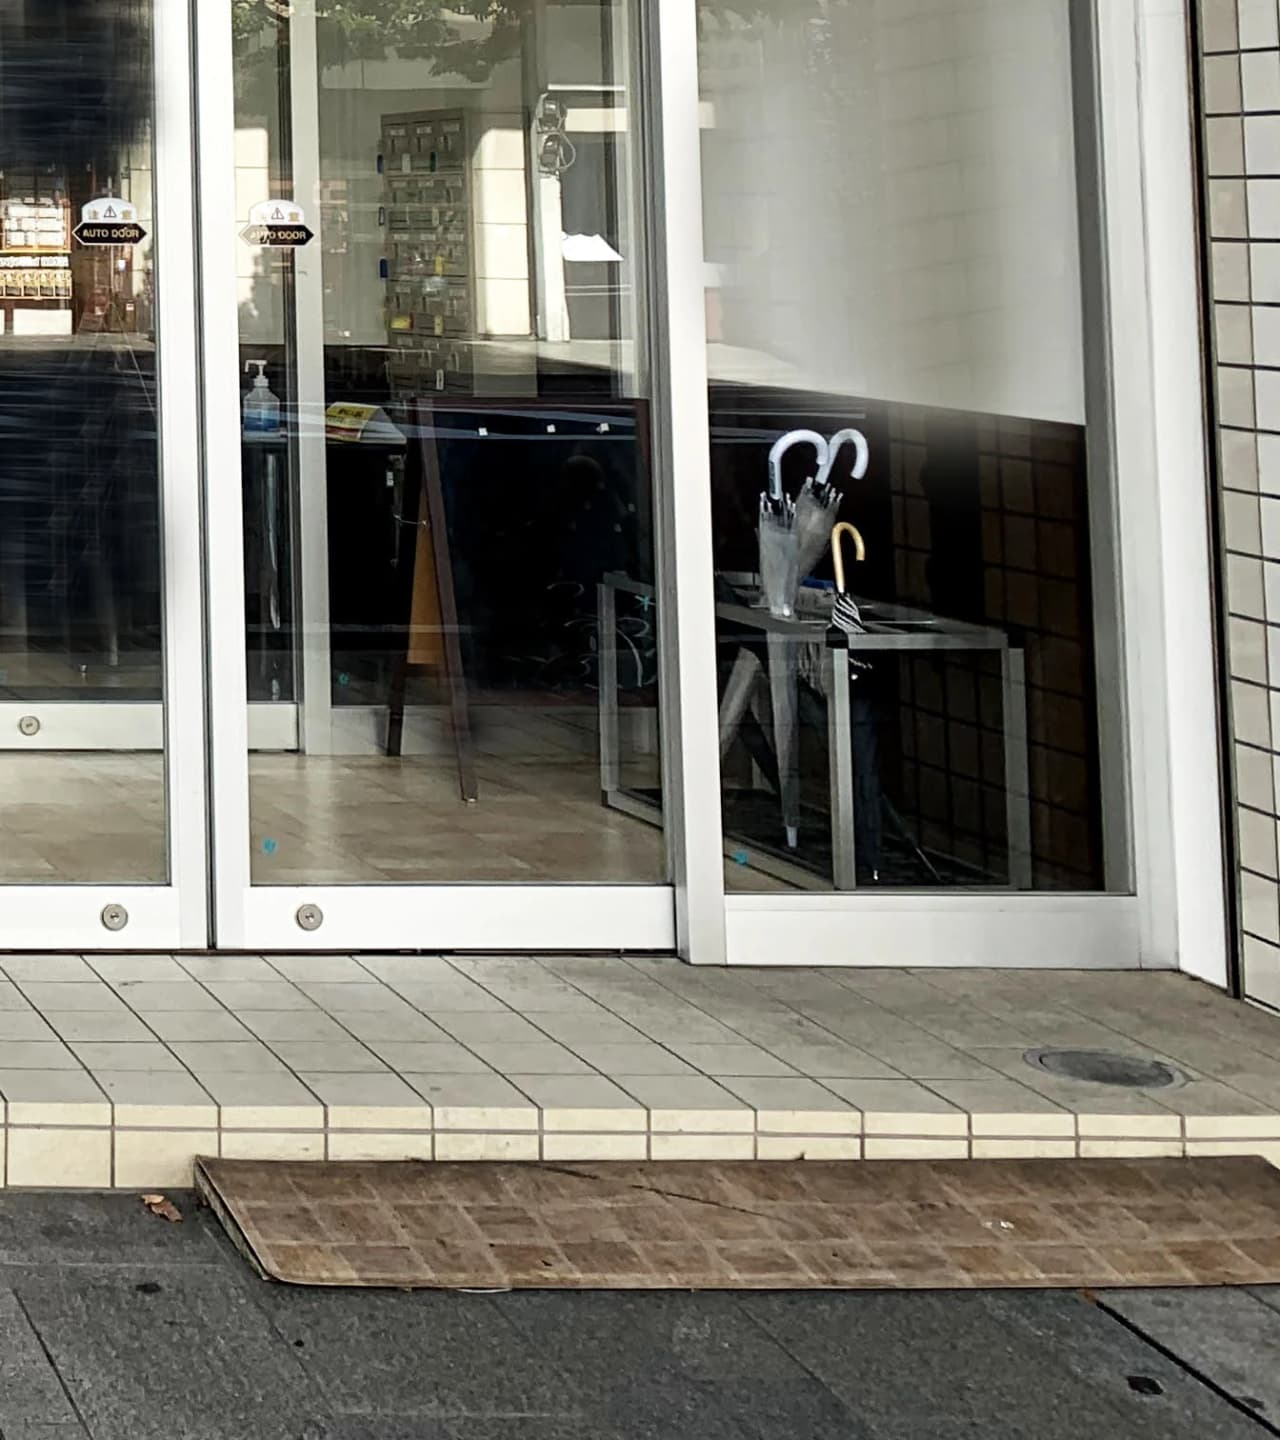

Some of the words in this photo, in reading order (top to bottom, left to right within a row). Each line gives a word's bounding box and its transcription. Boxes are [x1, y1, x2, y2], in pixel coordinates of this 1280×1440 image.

[82, 229, 110, 239] AUTO
[111, 228, 140, 239] DOOR
[277, 230, 307, 241] DOOR
